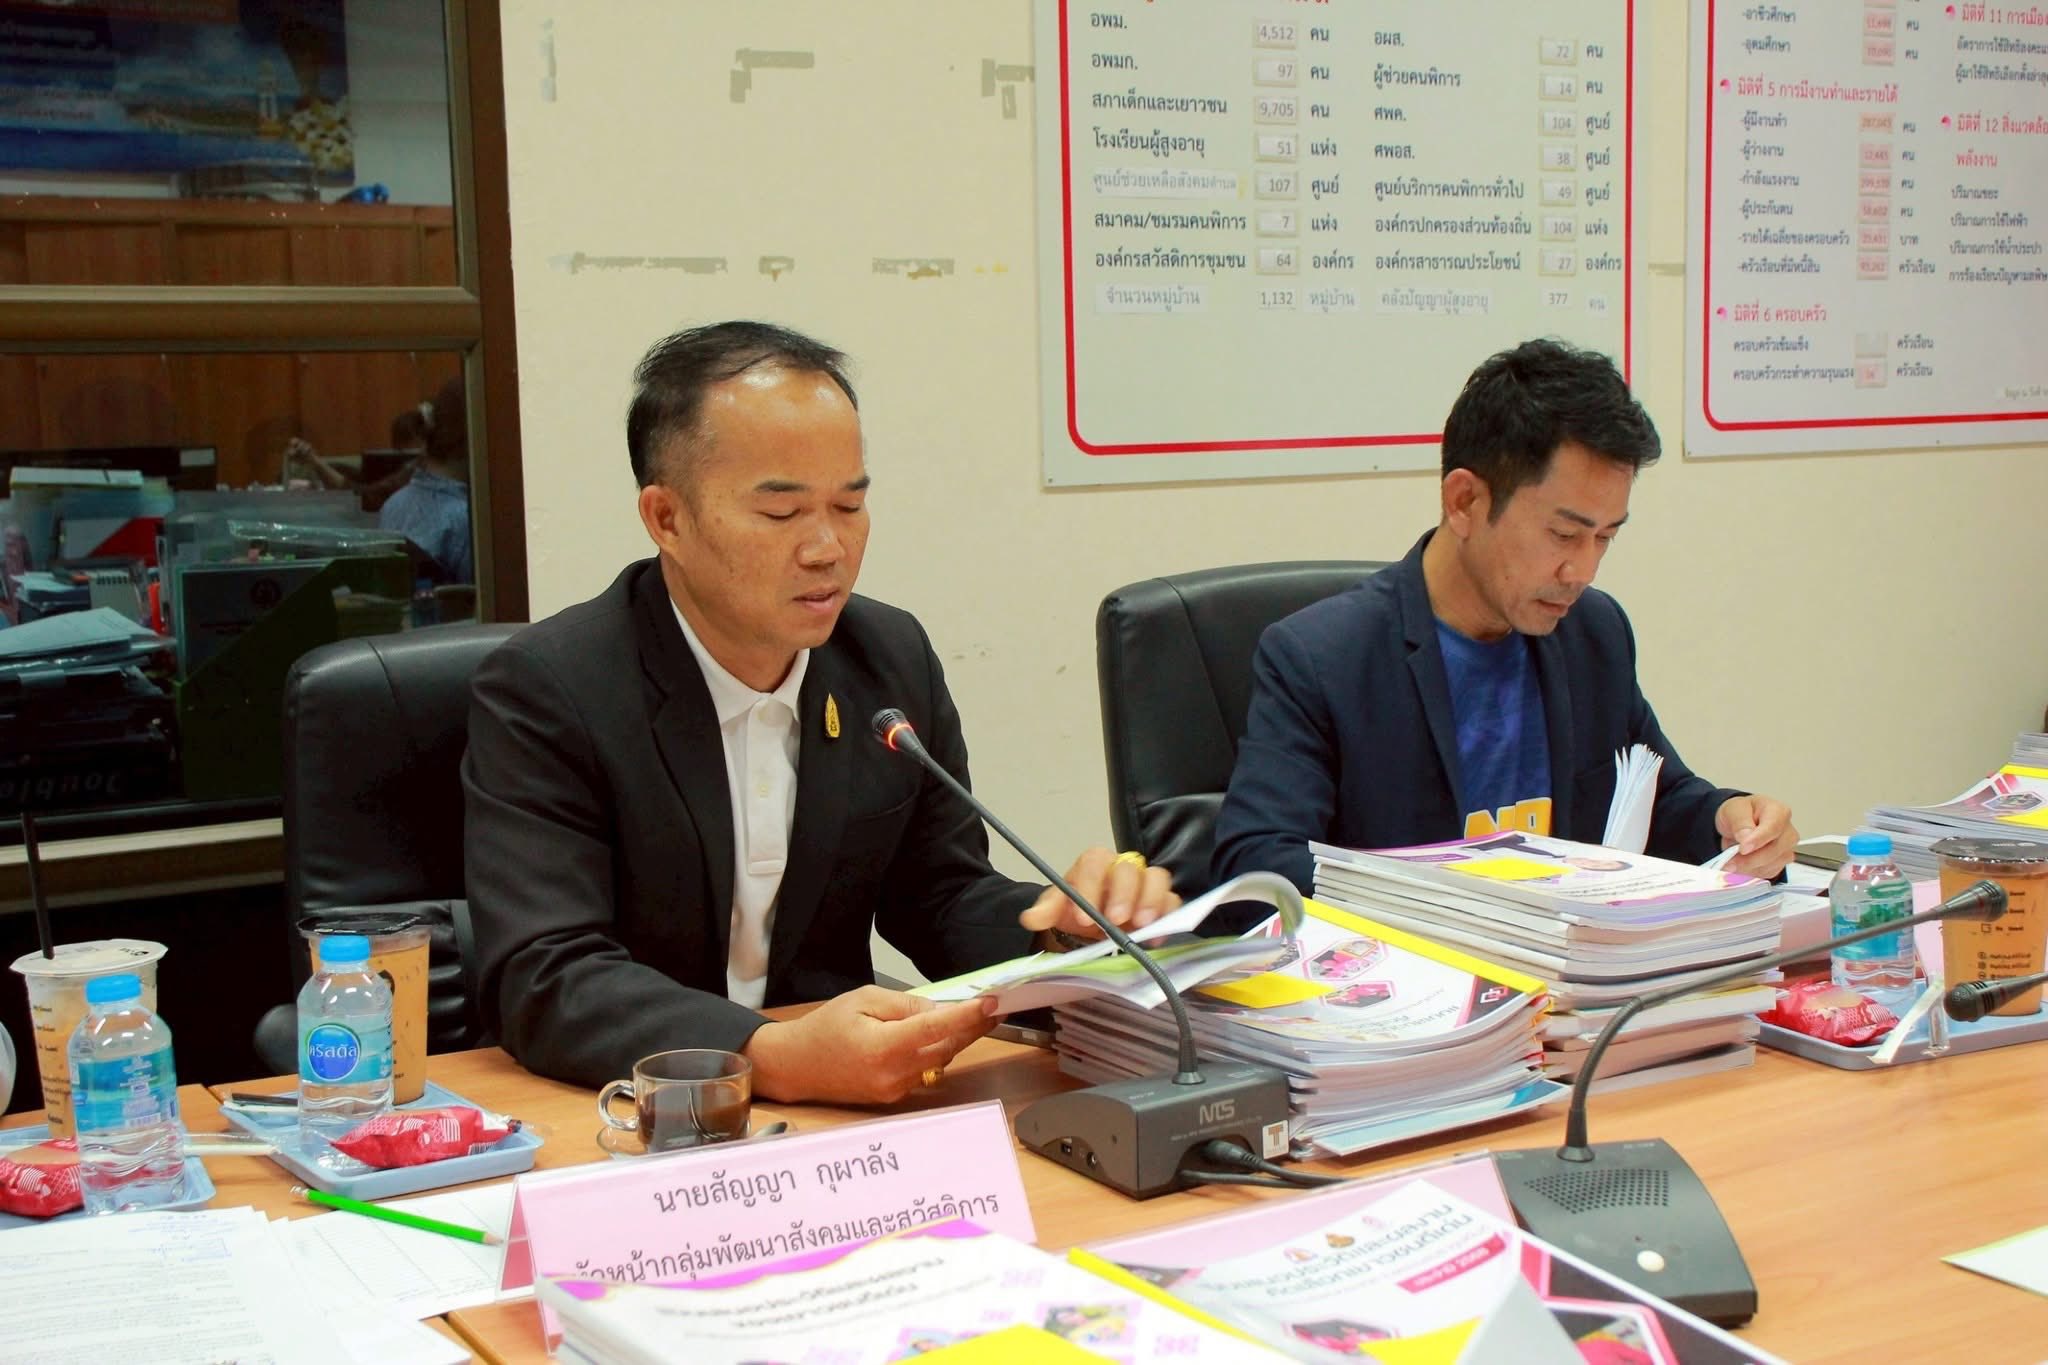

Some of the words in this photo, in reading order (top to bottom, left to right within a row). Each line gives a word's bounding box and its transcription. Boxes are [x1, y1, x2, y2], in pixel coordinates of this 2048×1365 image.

[1091, 12, 1127, 29] อพม.
[1260, 25, 1294, 41] 4,512
[1310, 28, 1329, 41] คน
[1907, 20, 1919, 31] คน
[1990, 9, 2001, 23] 11
[1374, 31, 1404, 47] อผส.
[1557, 46, 1569, 58] 72
[1586, 45, 1603, 58] คน
[1906, 49, 1918, 60] คน
[1091, 53, 1138, 70] อพมก.
[1278, 65, 1293, 78] 97
[1310, 66, 1329, 80] คน
[1374, 63, 1461, 89] ผู้ช่วยคนพิการ
[1559, 82, 1572, 95] 14
[1586, 81, 1603, 94] คน
[1738, 73, 1763, 96] มิติที่
[1769, 83, 1776, 96] 5
[1780, 79, 1899, 102] การมีงานทำและรายได้
[1092, 87, 1228, 114] สภาเด็กและเยาวชน
[1259, 103, 1294, 117] 9,705
[1311, 105, 1330, 118] คน
[1552, 117, 1571, 129] 104
[1586, 112, 1610, 136] ศูนย์
[1903, 122, 1916, 133] คน
[1986, 119, 1999, 133] 12
[1093, 127, 1205, 158] โรงเรียนผู้สูงอายุ
[1277, 143, 1292, 155] 51
[1311, 137, 1337, 156] แห่ง
[1557, 153, 1570, 165] 38
[1586, 148, 1610, 172] ศูนย์
[1902, 150, 1915, 161] คน
[1269, 179, 1290, 192] 107
[1311, 174, 1340, 200] ศูนย์
[1375, 176, 1524, 202] ศูนย์บริการคนพิการทั่วไป
[1558, 187, 1571, 198] 49
[1585, 182, 1610, 206] ศูนย์
[1901, 178, 1914, 189] คน
[1095, 209, 1246, 229] สมาคม/ชมรมคนพิการ
[1282, 216, 1290, 228] 7
[1311, 217, 1338, 232] แห่ง
[1375, 211, 1531, 235] องค์กรปกครองส่วนท้องถิ่น
[1553, 222, 1572, 234] 104
[1585, 219, 1608, 236] แห่ง
[1900, 207, 1913, 218] คน
[1900, 232, 1918, 245] บาท
[1095, 246, 1246, 274] องค์กรสวัสดิการชุมชน
[1276, 253, 1291, 267] 64
[1312, 250, 1354, 269] องค์กร
[1375, 248, 1521, 271] องค์กรสาธารณประโยชน์
[1558, 257, 1571, 269] 27
[1586, 253, 1622, 271] องค์กร
[1899, 258, 1935, 273] ครัวเรือน
[1106, 285, 1200, 312] จำนวนหมู่บ้าน
[1261, 291, 1293, 307] 1,132
[1309, 291, 1354, 312] หมู่บ้าน
[1549, 293, 1567, 306] 377
[1734, 299, 1759, 321] มิติที่
[1764, 308, 1770, 321] 6
[1776, 304, 1827, 321] ครอบครัว
[1897, 334, 1934, 349] ครัวเรือน
[1896, 361, 1933, 376] ครัวเรือน
[654, 1169, 797, 1213] นายสัญญา
[816, 1143, 899, 1193] กุผาลัง
